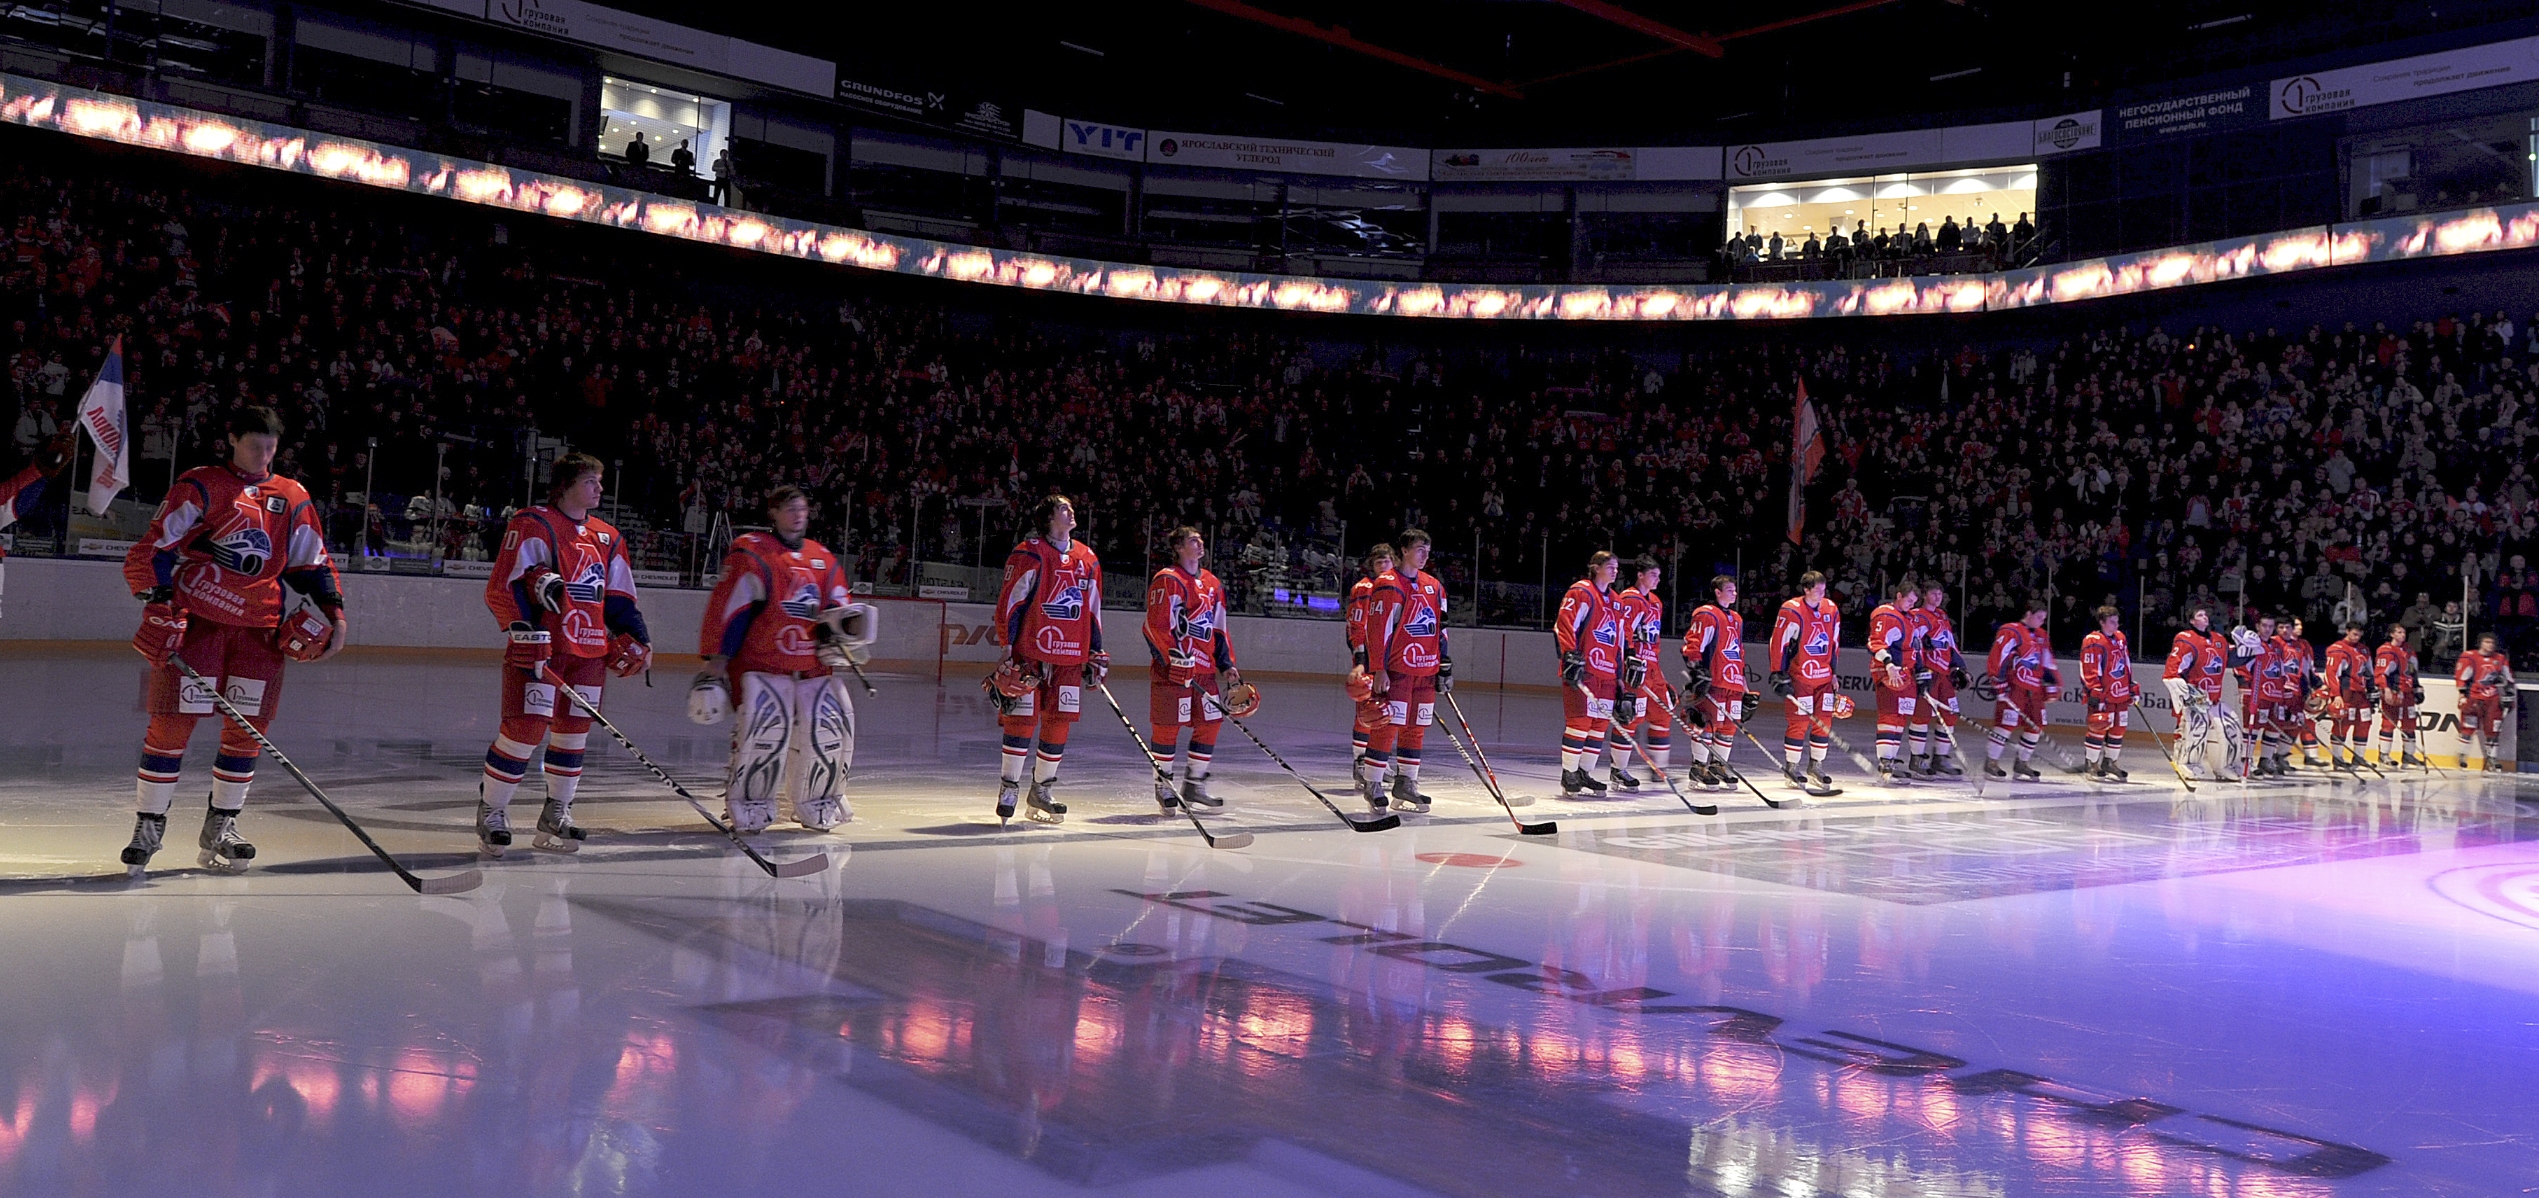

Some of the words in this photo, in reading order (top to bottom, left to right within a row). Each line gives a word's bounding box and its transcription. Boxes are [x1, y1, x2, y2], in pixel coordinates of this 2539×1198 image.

[524, 8, 566, 24] грузовая
[523, 20, 569, 35] компания
[840, 79, 923, 106] GRUNDFOS
[2305, 89, 2351, 104] грузовая
[2119, 85, 2251, 118] НЕГОСУДАРСТВЕННЫЙ
[2304, 99, 2355, 113] компания
[2124, 108, 2205, 129] ПЕНСИОННЫЙ
[2208, 101, 2244, 115] ФОНД
[1069, 123, 1142, 151] YIT
[1181, 139, 1257, 153] ЯРОСЛАВСКИЙ
[1258, 144, 1335, 158] ТЕХНИЧЕСКИЙ
[1236, 154, 1282, 165] УГЛЕРОД
[1753, 158, 1788, 169] грузовая
[1753, 167, 1791, 177] компания
[199, 579, 246, 606] грузовая
[1150, 588, 1165, 606] 97
[192, 587, 245, 618] компания
[1690, 622, 1702, 634] 41
[1875, 620, 1883, 632] 5
[2083, 652, 2095, 664] 61
[1109, 888, 2393, 1178] CHEVROLET
